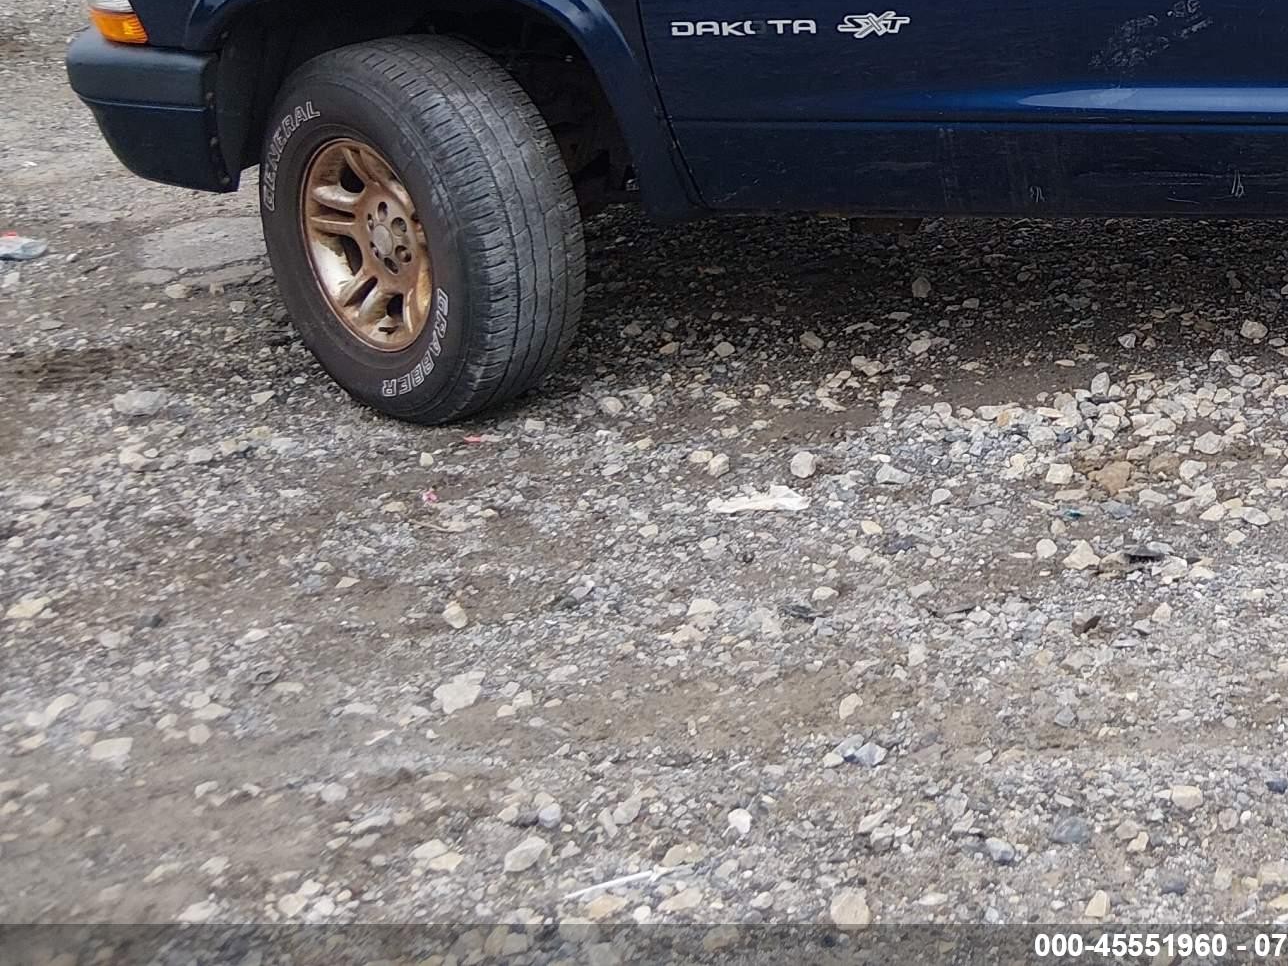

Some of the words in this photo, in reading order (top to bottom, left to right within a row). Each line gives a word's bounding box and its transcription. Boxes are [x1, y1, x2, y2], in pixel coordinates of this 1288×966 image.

[837, 10, 911, 39] SXT
[263, 101, 321, 211] GENERAL
[382, 288, 449, 397] GRABBER
